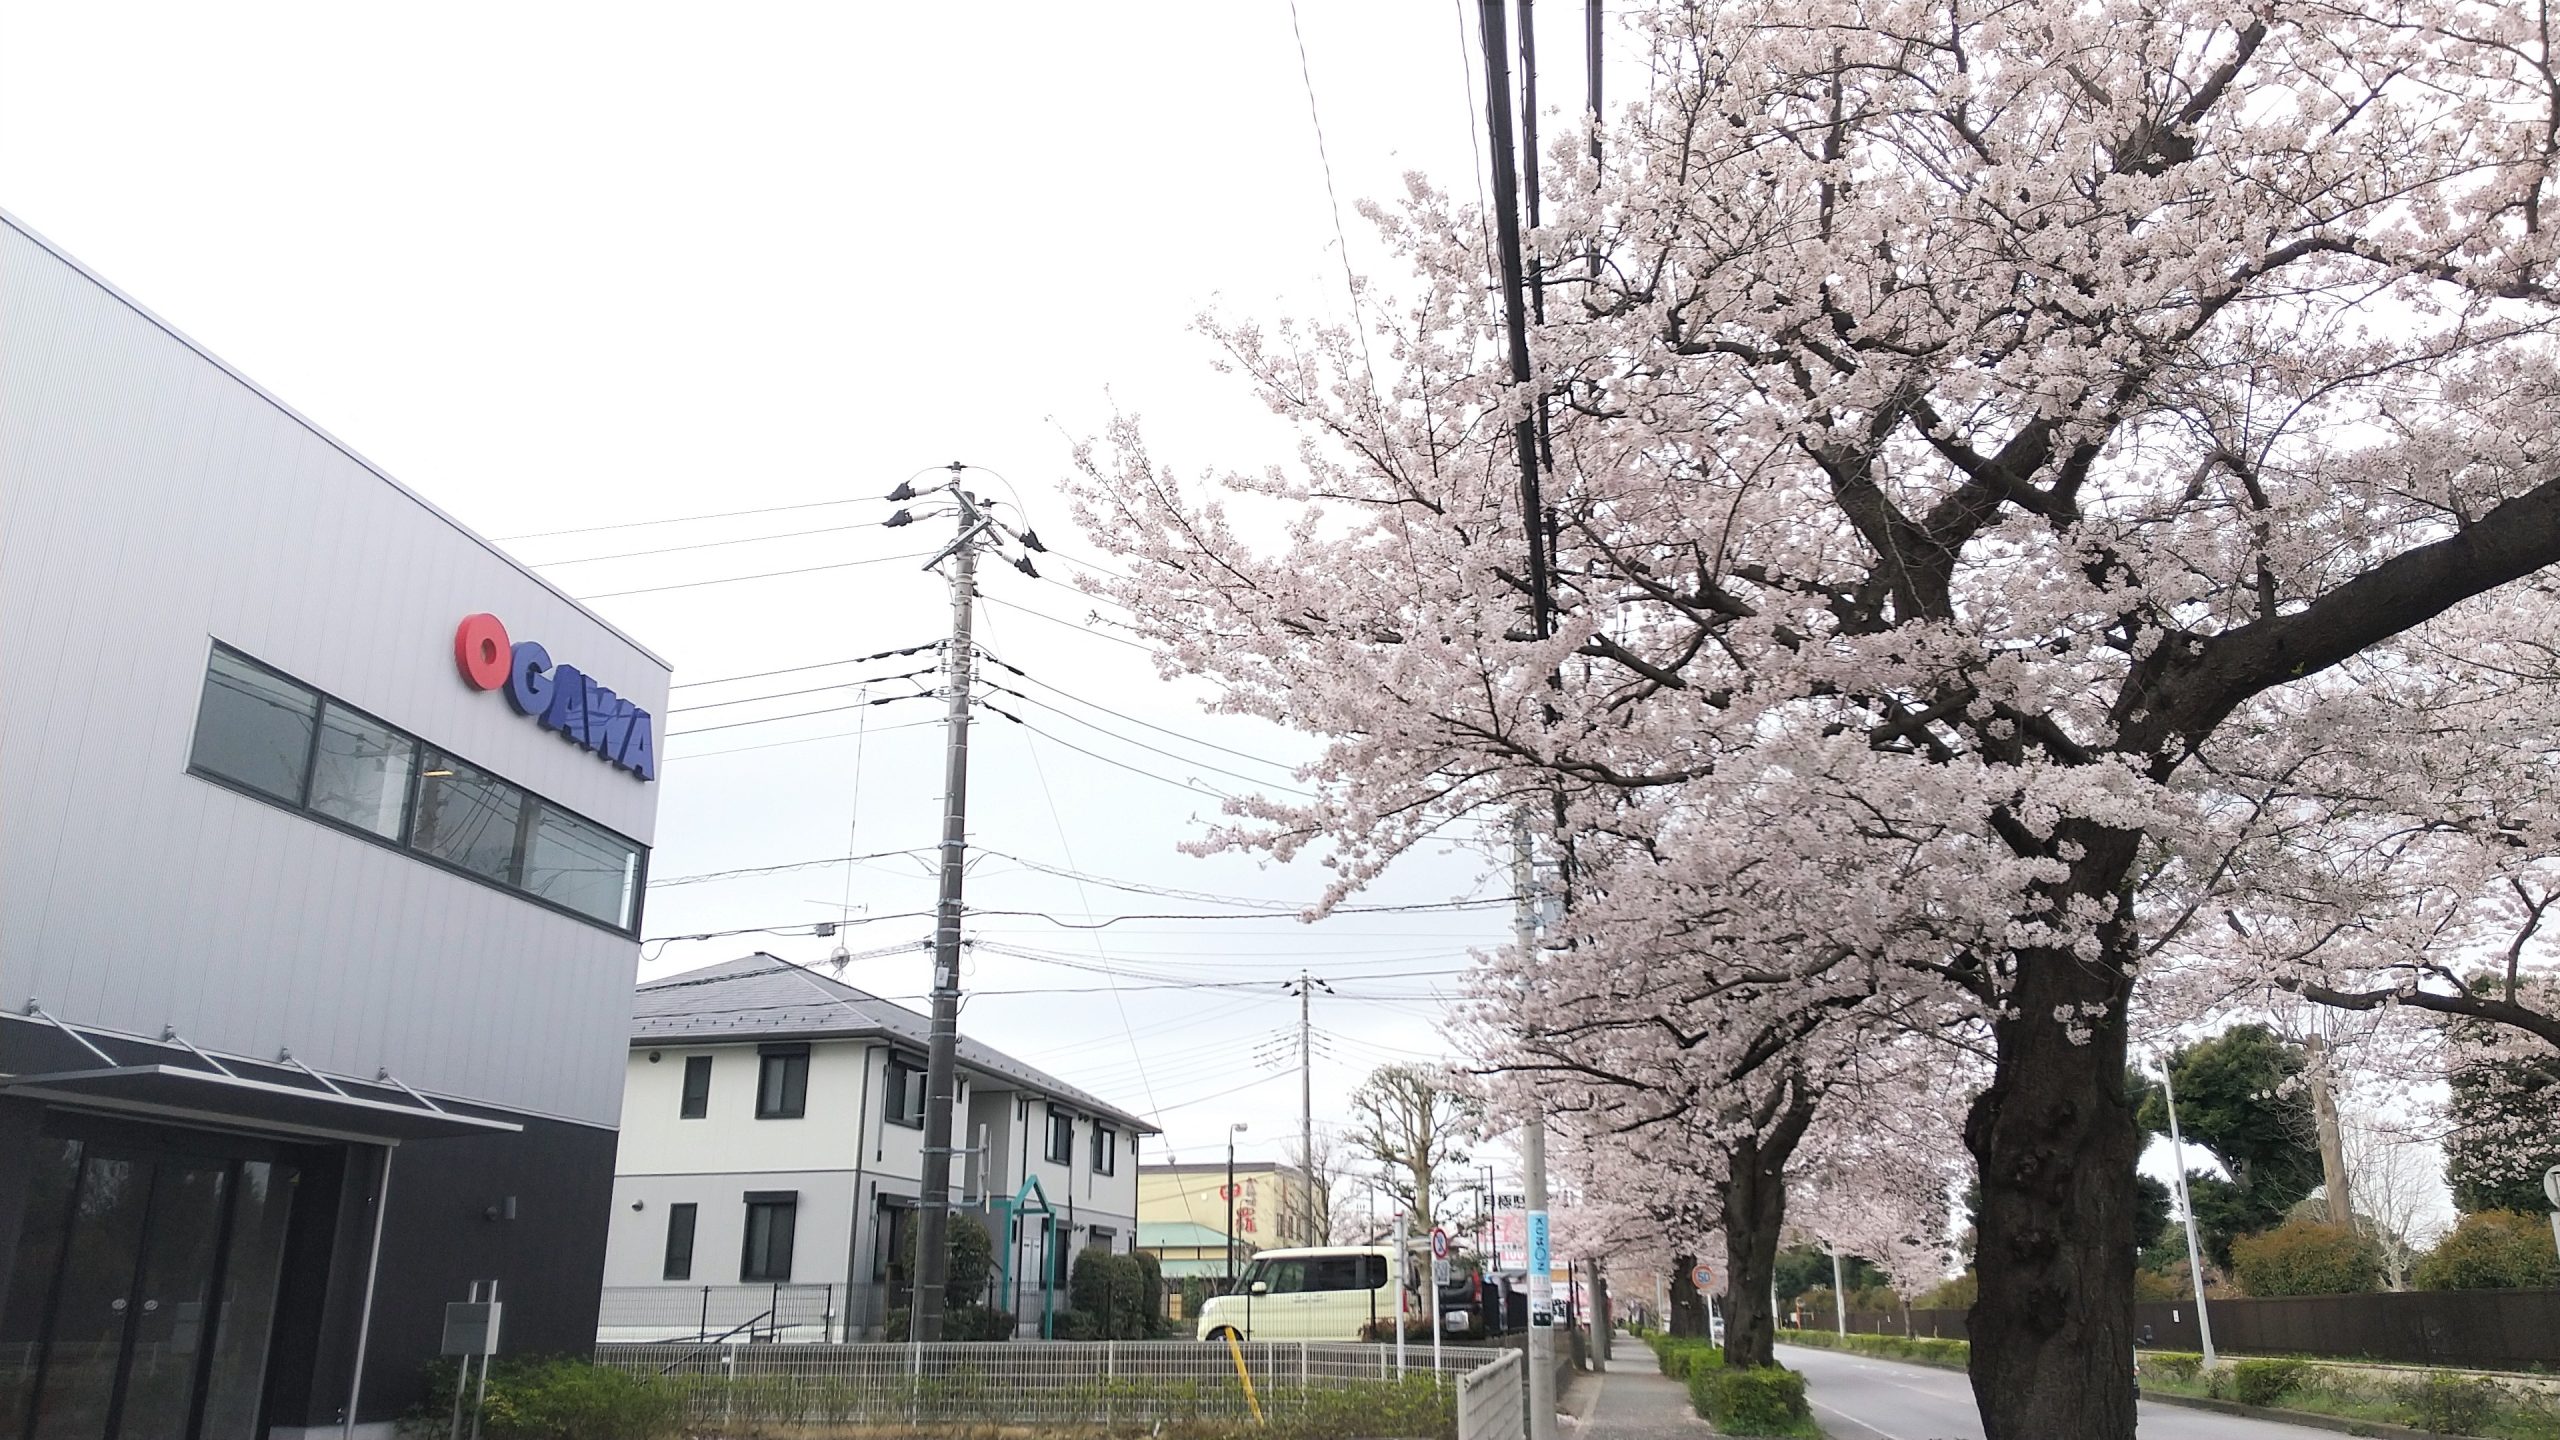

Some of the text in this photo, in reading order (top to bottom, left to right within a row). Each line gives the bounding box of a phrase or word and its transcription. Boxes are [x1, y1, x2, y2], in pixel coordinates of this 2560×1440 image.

[455, 612, 654, 782] OGAWA
[1535, 1217, 1546, 1271] KUMON
[1697, 1271, 1711, 1283] 50
